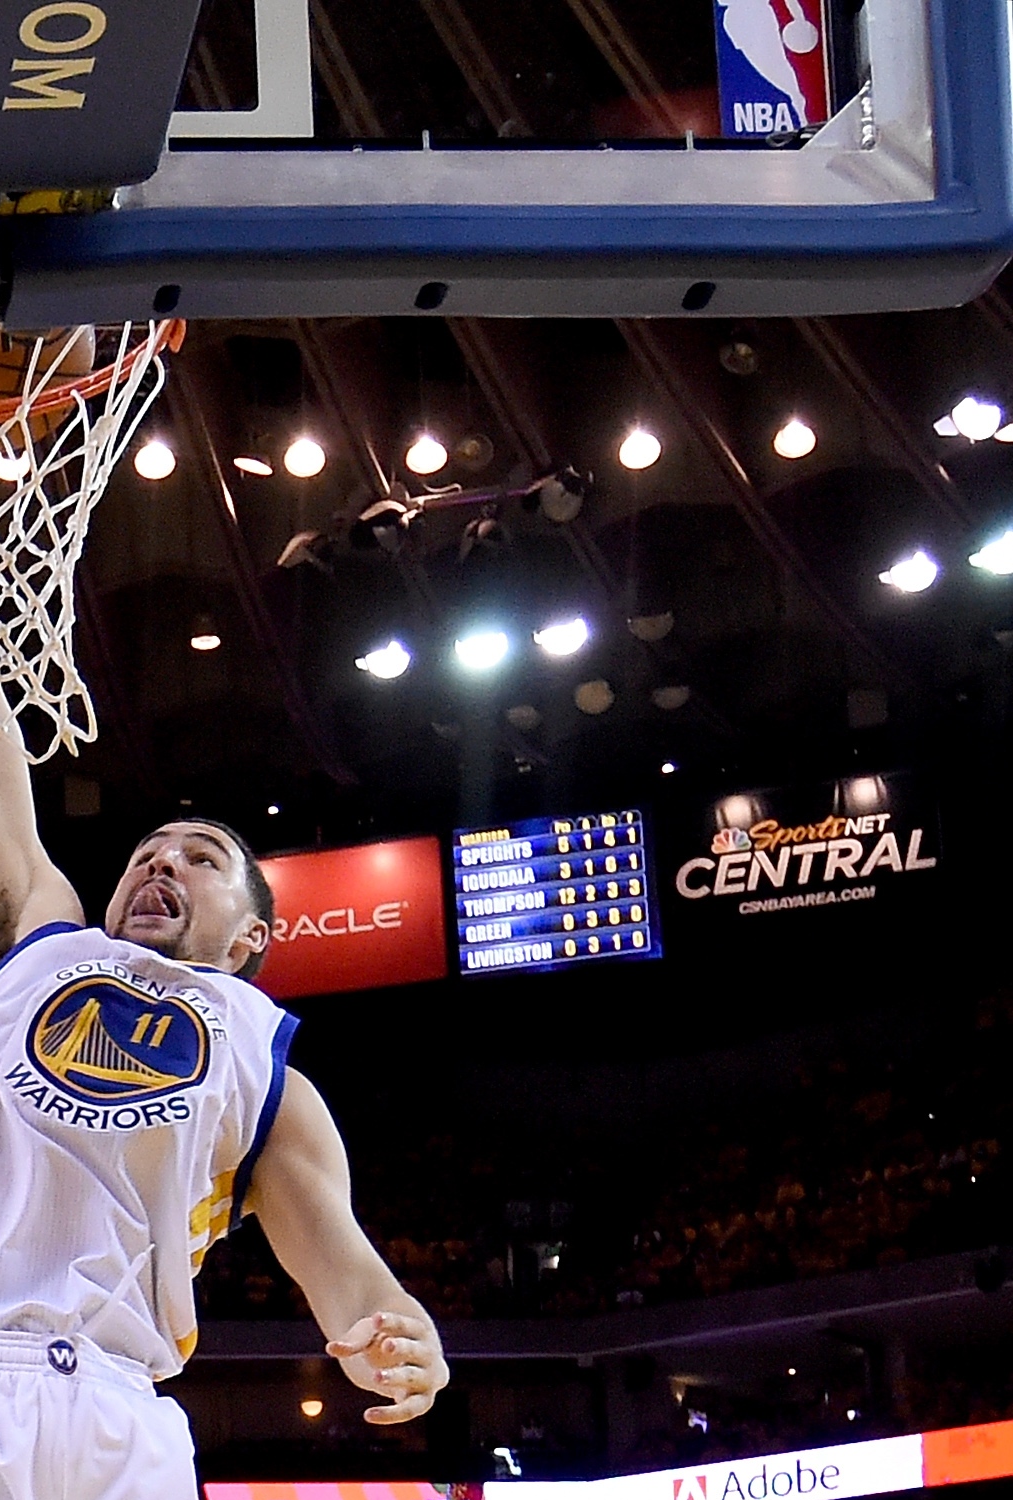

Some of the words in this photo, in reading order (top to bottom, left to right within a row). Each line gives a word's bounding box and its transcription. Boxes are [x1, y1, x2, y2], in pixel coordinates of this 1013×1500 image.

[734, 102, 794, 133] NBA
[460, 841, 533, 866] SPEIGHTS
[583, 833, 592, 850] 1
[603, 829, 616, 847] 4
[627, 827, 636, 844] 1
[675, 829, 937, 899] CENTRAL
[462, 867, 535, 892] IGUODALA
[559, 861, 571, 879] 3
[584, 858, 594, 876] 1
[628, 853, 638, 870] 1
[463, 890, 545, 917] THOMPSON
[558, 887, 576, 905] 12
[586, 884, 596, 902] 2
[607, 881, 618, 899] 3
[628, 878, 640, 896] 3
[739, 886, 876, 914] CSNBAYAREA.COM
[272, 902, 403, 942] RACLE
[465, 922, 512, 943] GREEN
[586, 910, 598, 927] 3
[467, 941, 552, 969] LIVINGSTON
[588, 936, 600, 953] 3
[612, 933, 621, 950] 1
[56, 961, 166, 997] GOLDEN
[129, 1013, 174, 1048] 11
[5, 1062, 190, 1130] WARRIORS
